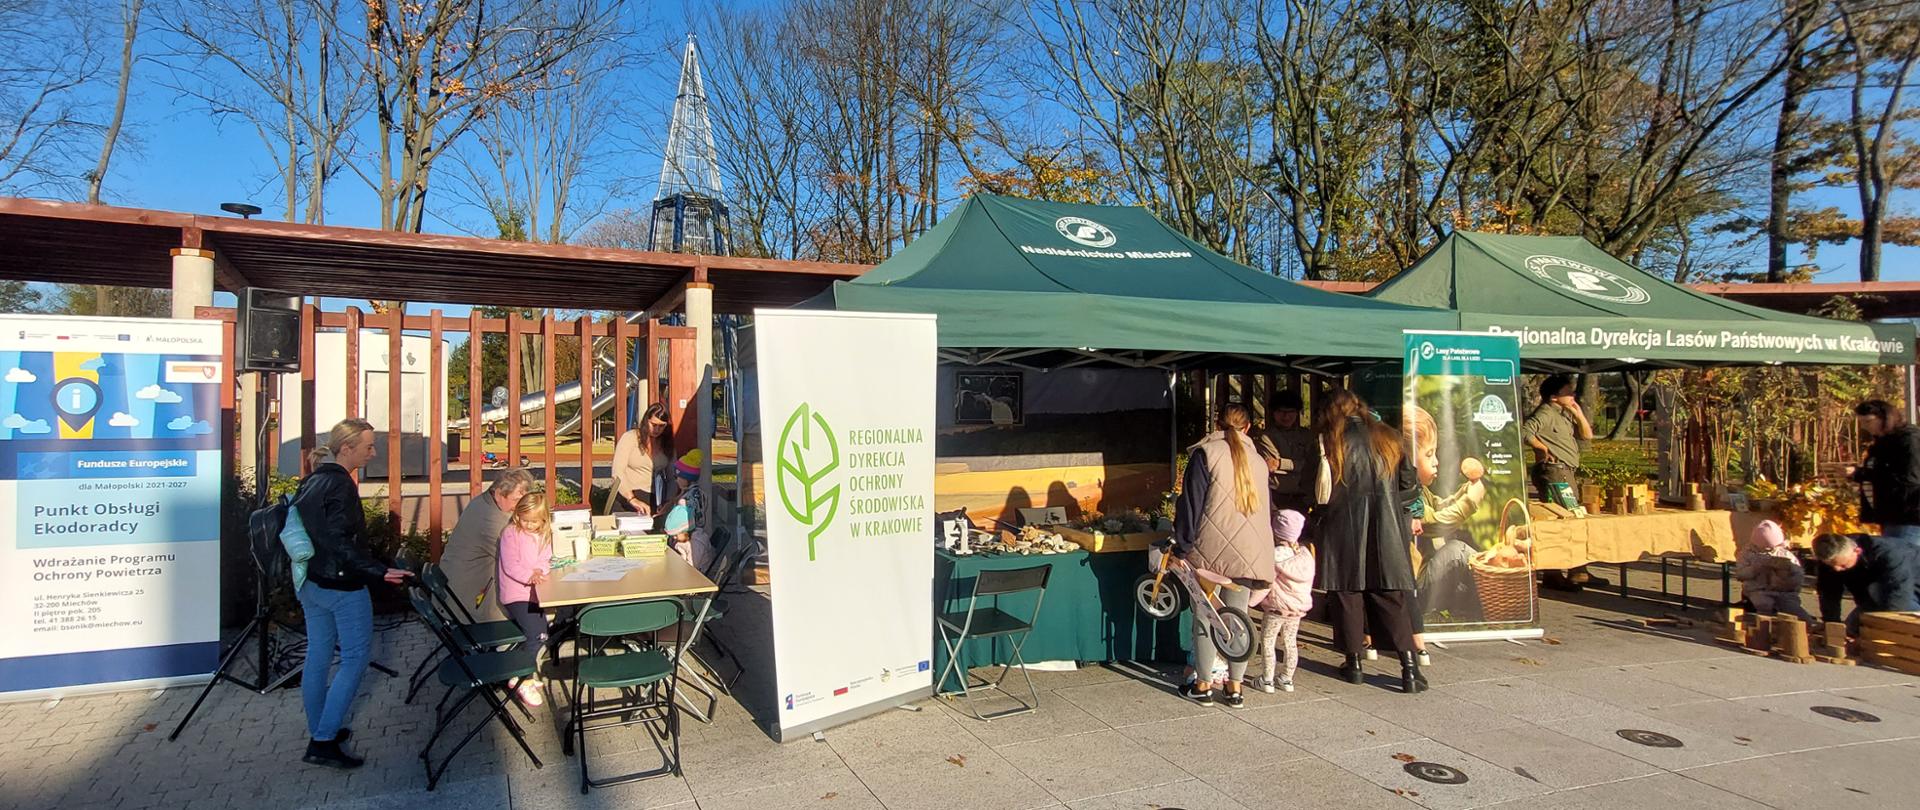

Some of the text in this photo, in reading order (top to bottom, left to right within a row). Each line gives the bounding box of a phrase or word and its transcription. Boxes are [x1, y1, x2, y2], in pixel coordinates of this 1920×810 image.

[1020, 245, 1193, 259] Nadleśnictwo Miechów
[1591, 327, 1661, 350] Dyrekcja
[1666, 329, 1717, 348] Lasów
[1720, 331, 1823, 353] Państwowych
[1824, 337, 1838, 350] w
[1840, 335, 1904, 353] Krakowie
[849, 428, 923, 445] REGIONALNA
[77, 458, 188, 469] Fundusze Europejskie
[849, 451, 906, 469] DYREKCJA
[78, 481, 188, 493] dla Małopolski 2021-2027
[849, 473, 904, 492] OCHRONY
[34, 501, 160, 517] Punkt Obsługi
[849, 495, 925, 515] ŚRODOWISKA
[34, 520, 139, 535] Ekodoradcy
[850, 517, 923, 538] W KRAKOWIE
[33, 553, 176, 568] Wdrażanie Programu
[33, 567, 162, 582] Ochrony Powietrza
[46, 593, 81, 602] Henryka
[83, 589, 133, 598] Sienkiewicza
